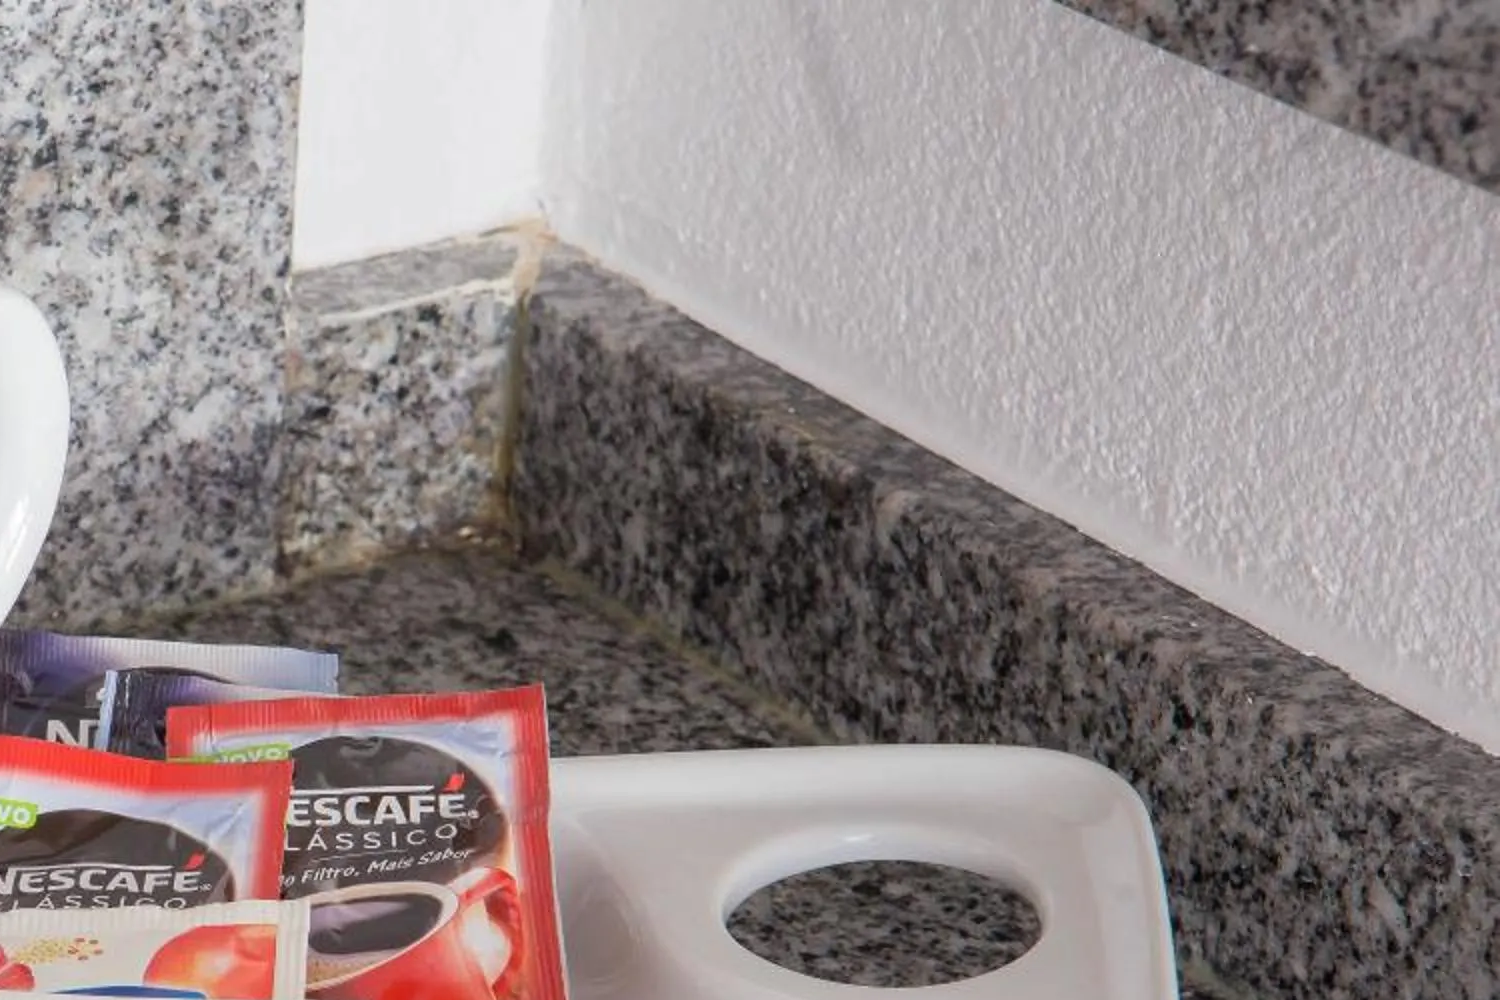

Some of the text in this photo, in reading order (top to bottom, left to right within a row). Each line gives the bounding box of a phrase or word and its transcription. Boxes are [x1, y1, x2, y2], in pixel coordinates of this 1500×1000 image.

[286, 772, 466, 826] ESCAFÉ
[284, 824, 458, 851] LÁSSICO
[367, 855, 412, 873] Mais
